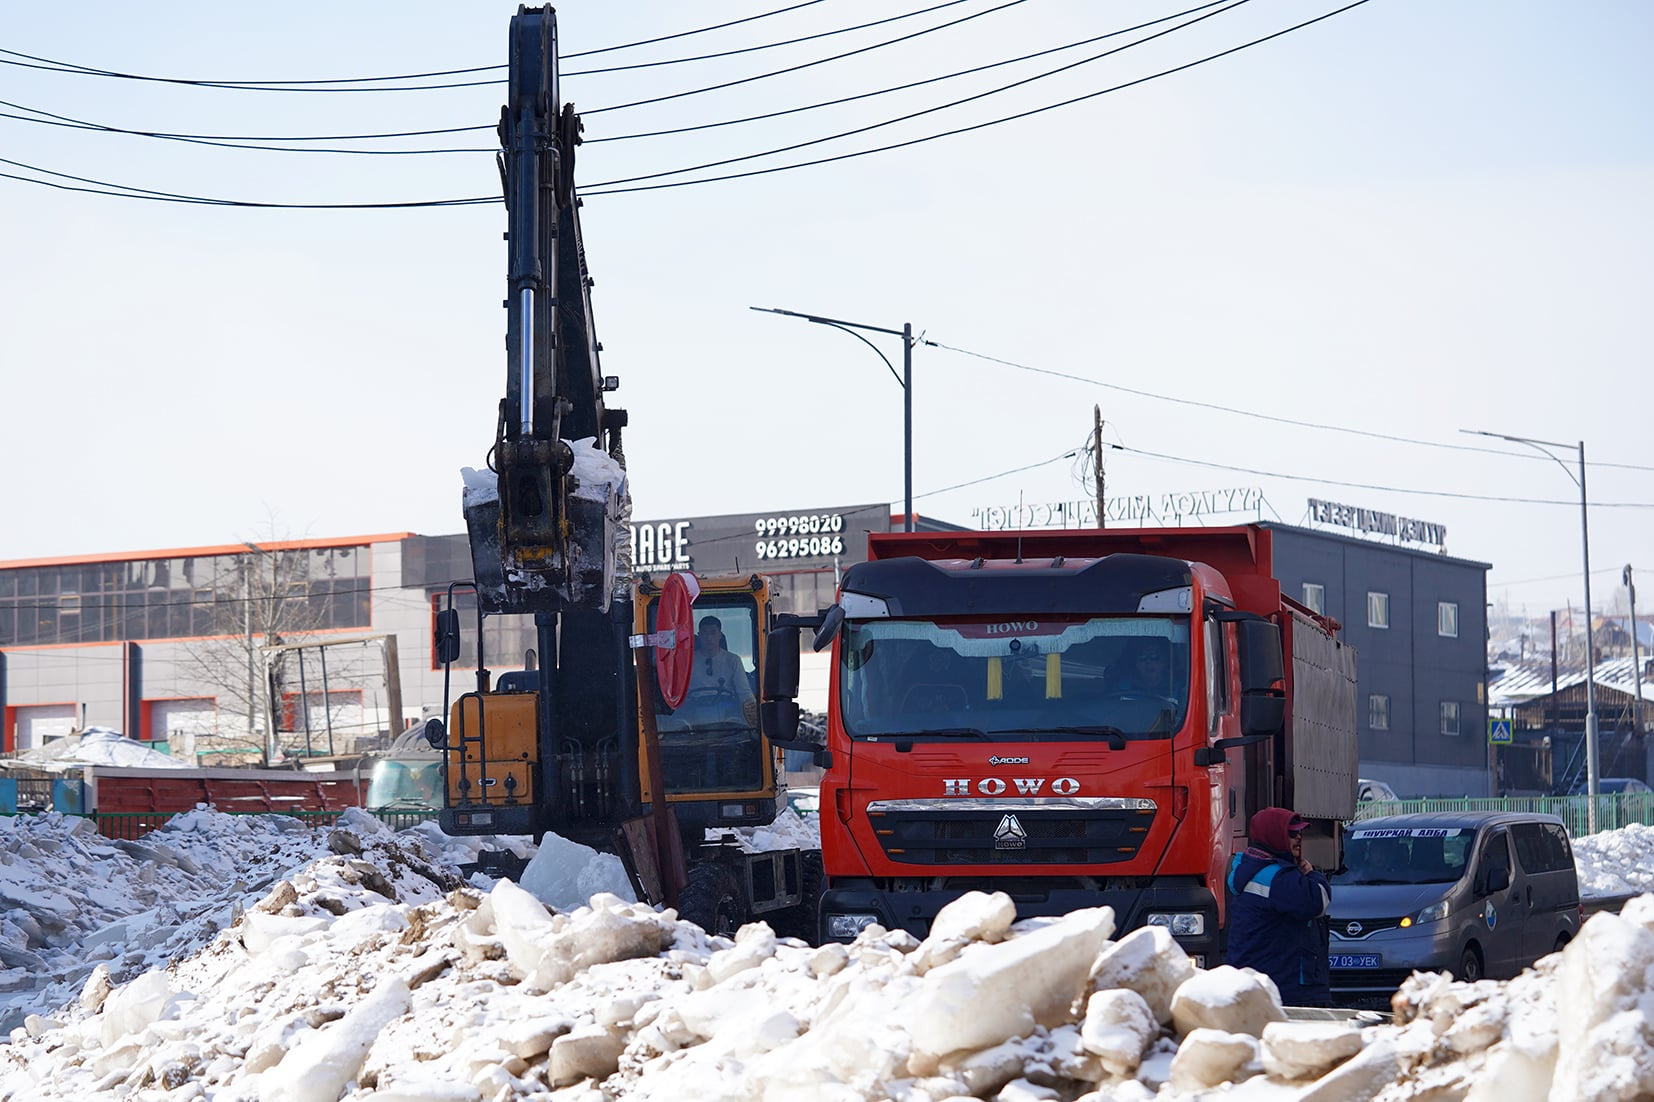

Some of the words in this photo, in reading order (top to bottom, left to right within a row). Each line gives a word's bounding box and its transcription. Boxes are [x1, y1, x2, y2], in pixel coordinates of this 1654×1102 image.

[755, 514, 842, 536] 99998020
[755, 536, 843, 559] 96295086
[986, 620, 1039, 634] HOWO
[943, 777, 1081, 796] HOWO
[1341, 956, 1353, 967] 03
